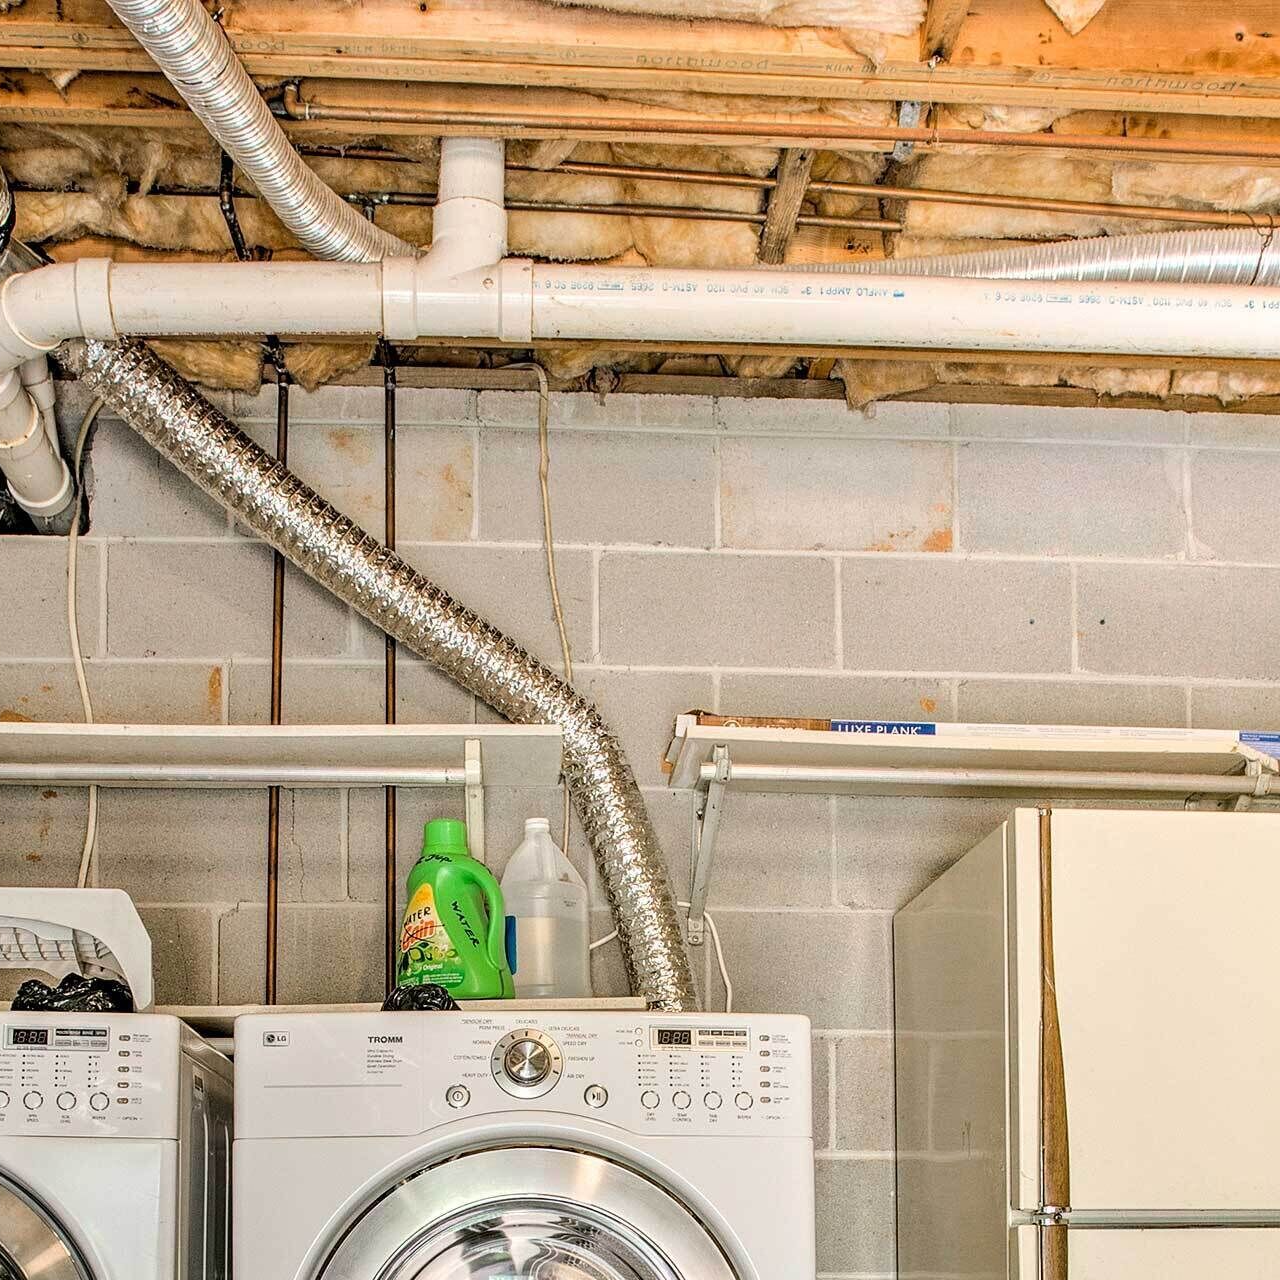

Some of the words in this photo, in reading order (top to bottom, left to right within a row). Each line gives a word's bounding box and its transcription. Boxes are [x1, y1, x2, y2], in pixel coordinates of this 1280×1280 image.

[635, 54, 769, 70] northwood
[1104, 77, 1237, 92] northwood
[837, 724, 871, 735] LUXE
[450, 900, 480, 948] WATER
